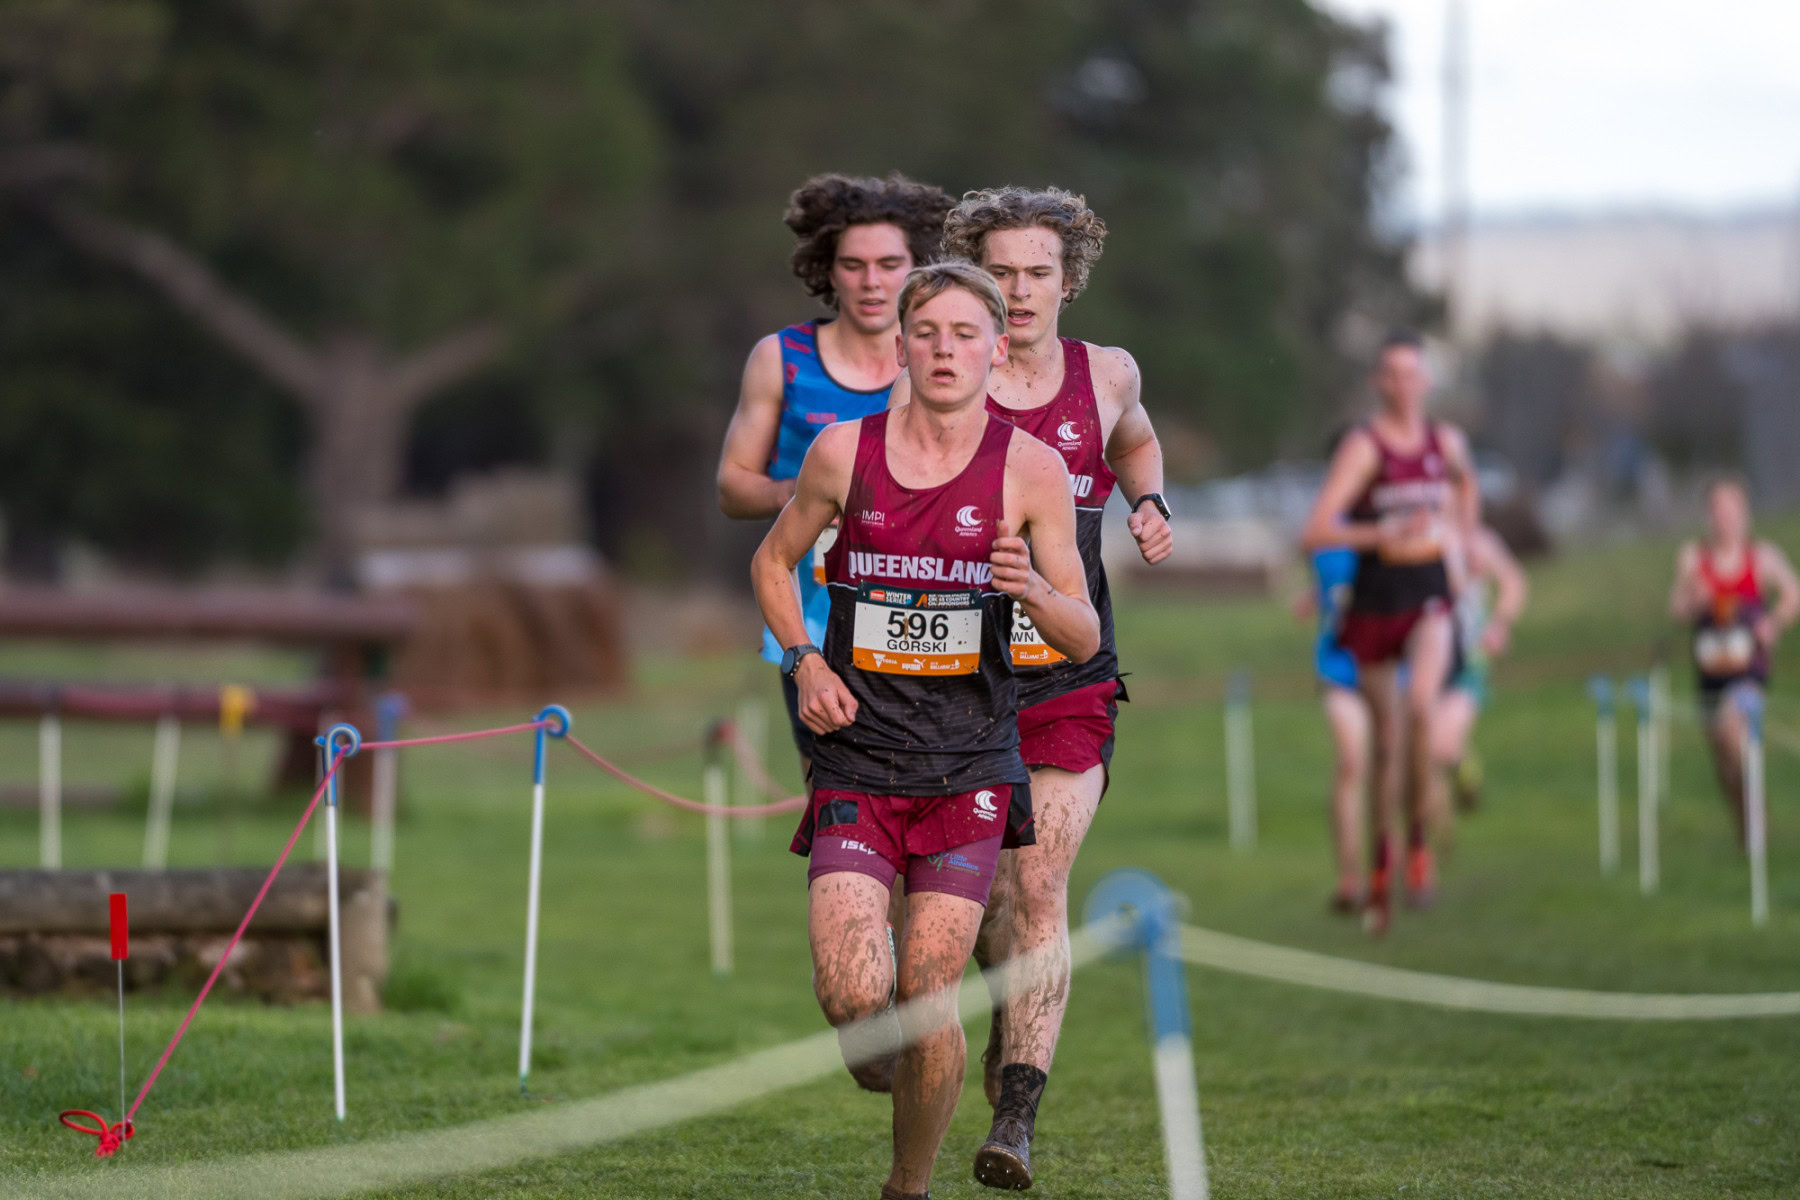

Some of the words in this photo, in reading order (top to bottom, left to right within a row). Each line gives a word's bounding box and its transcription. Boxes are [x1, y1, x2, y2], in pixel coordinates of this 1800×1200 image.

[862, 509, 885, 523] IMPI
[886, 590, 912, 600] WINTER
[887, 610, 949, 641] 596
[887, 639, 947, 653] GORSKI
